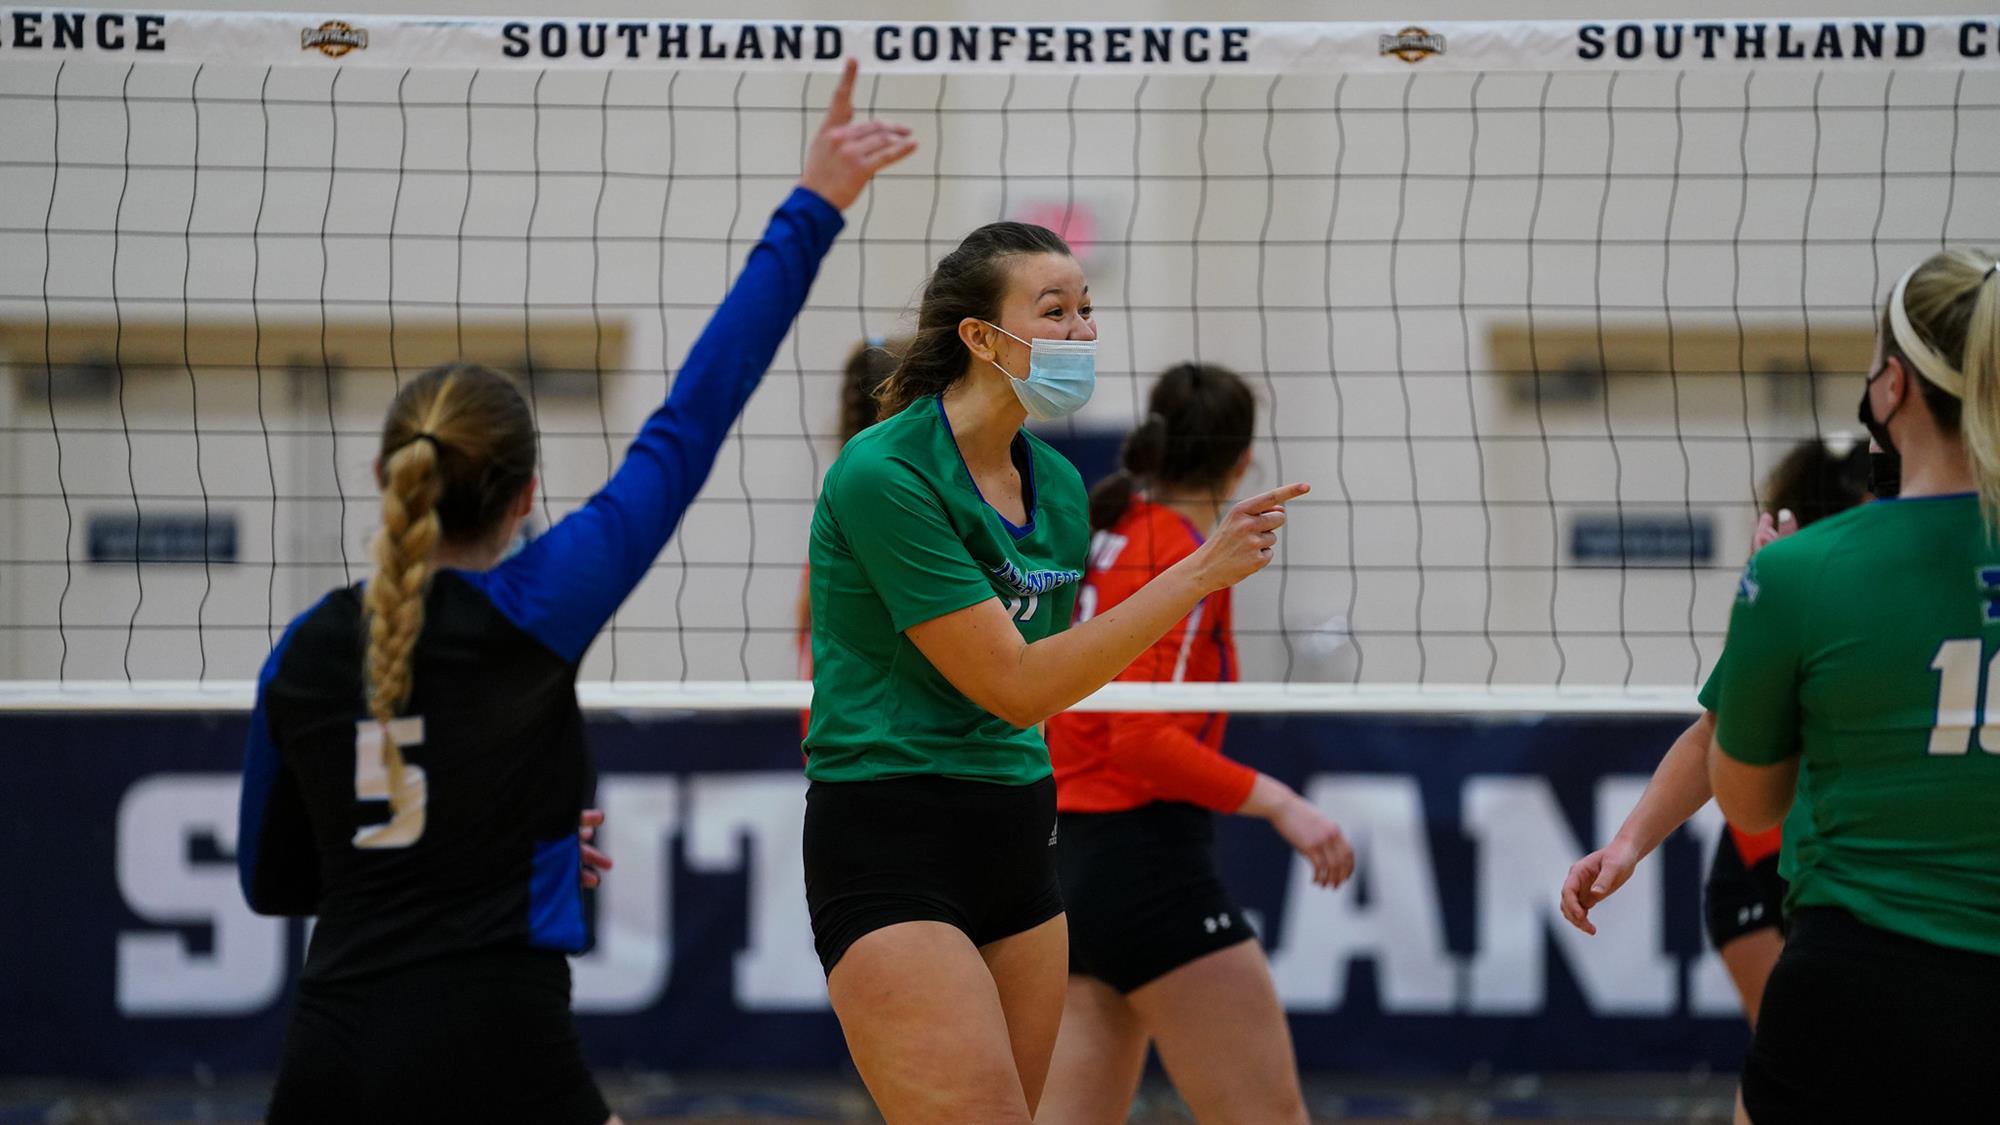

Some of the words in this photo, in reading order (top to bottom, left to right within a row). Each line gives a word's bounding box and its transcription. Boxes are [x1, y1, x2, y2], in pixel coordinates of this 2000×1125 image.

[0, 12, 166, 51] ENCE
[501, 22, 843, 60] SOUTHLAND
[874, 25, 1250, 62] CONFERENCE
[1577, 23, 1926, 59] SOUTHLAND
[1959, 22, 2000, 58] C
[351, 715, 427, 850] 5
